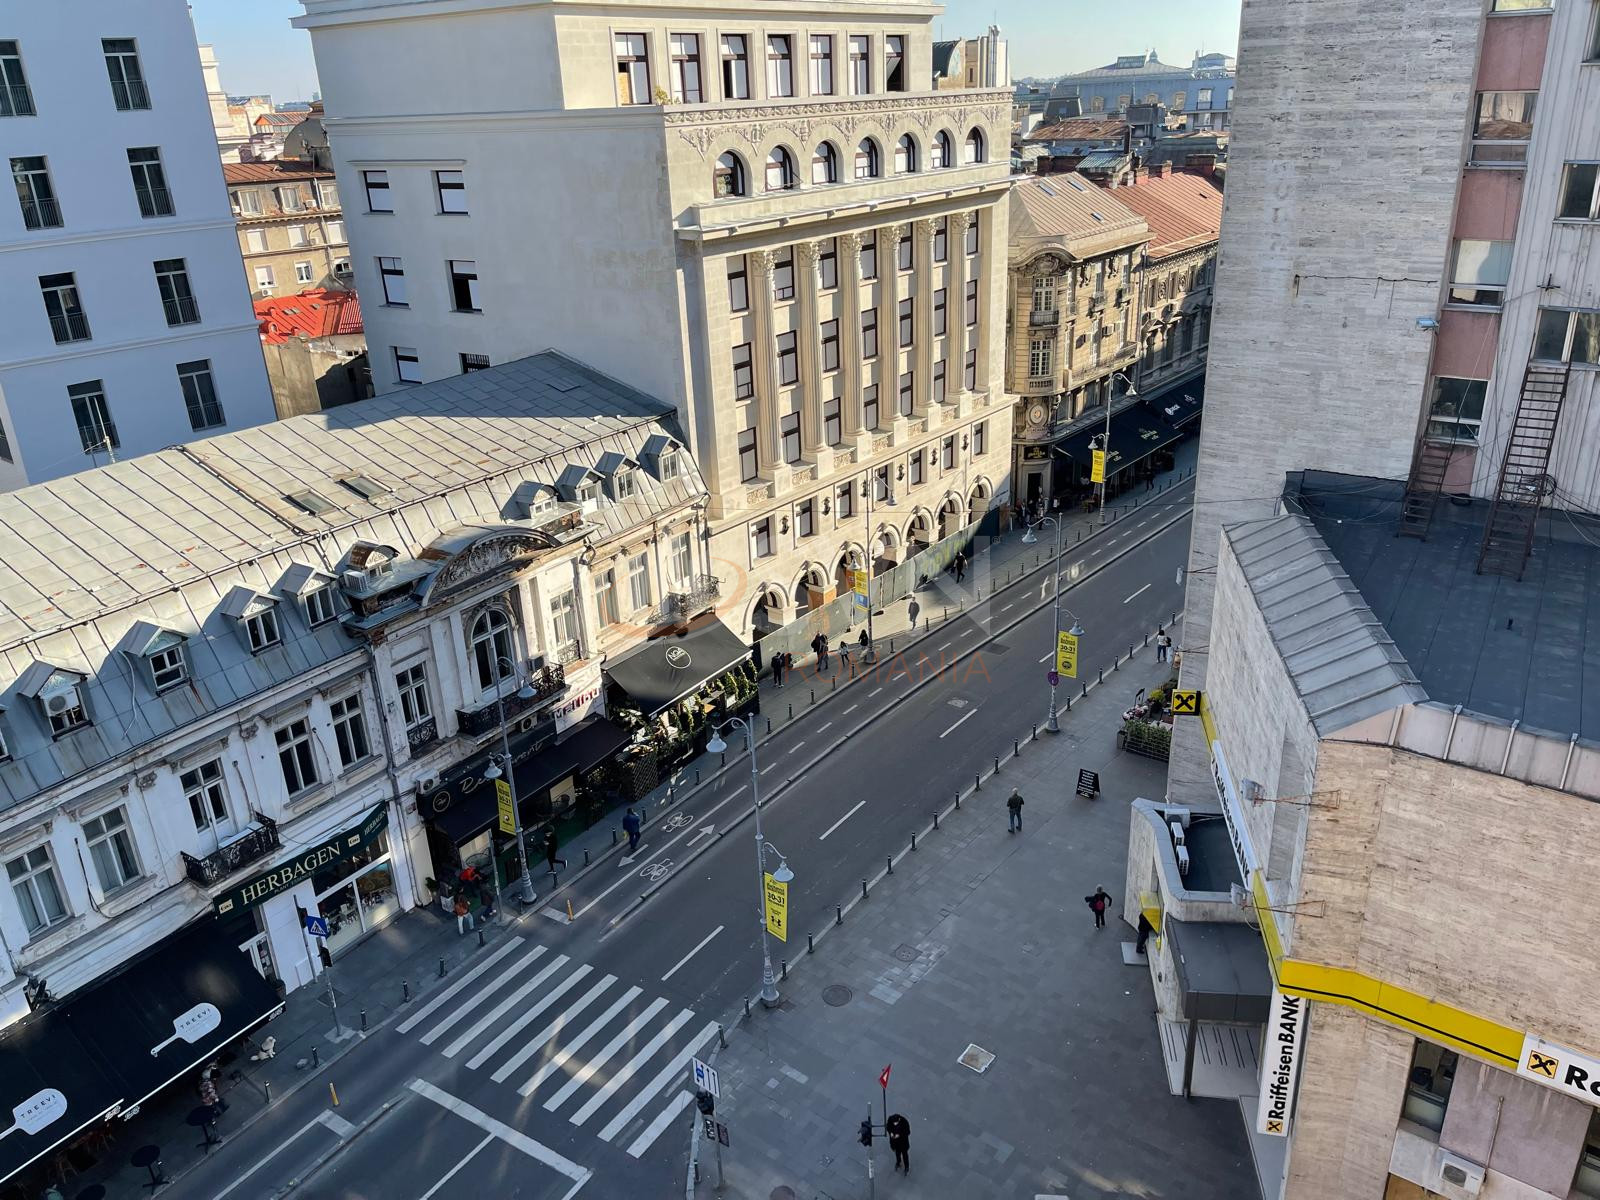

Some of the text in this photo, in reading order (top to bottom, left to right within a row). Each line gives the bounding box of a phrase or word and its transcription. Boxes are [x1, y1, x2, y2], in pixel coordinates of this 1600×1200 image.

[240, 842, 341, 905] HERBAGEN
[767, 891, 785, 905] 30-31
[180, 1007, 211, 1030] TREEVI
[1268, 994, 1300, 1120] RaiffeisenBANK
[20, 1094, 57, 1119] TREEVI
